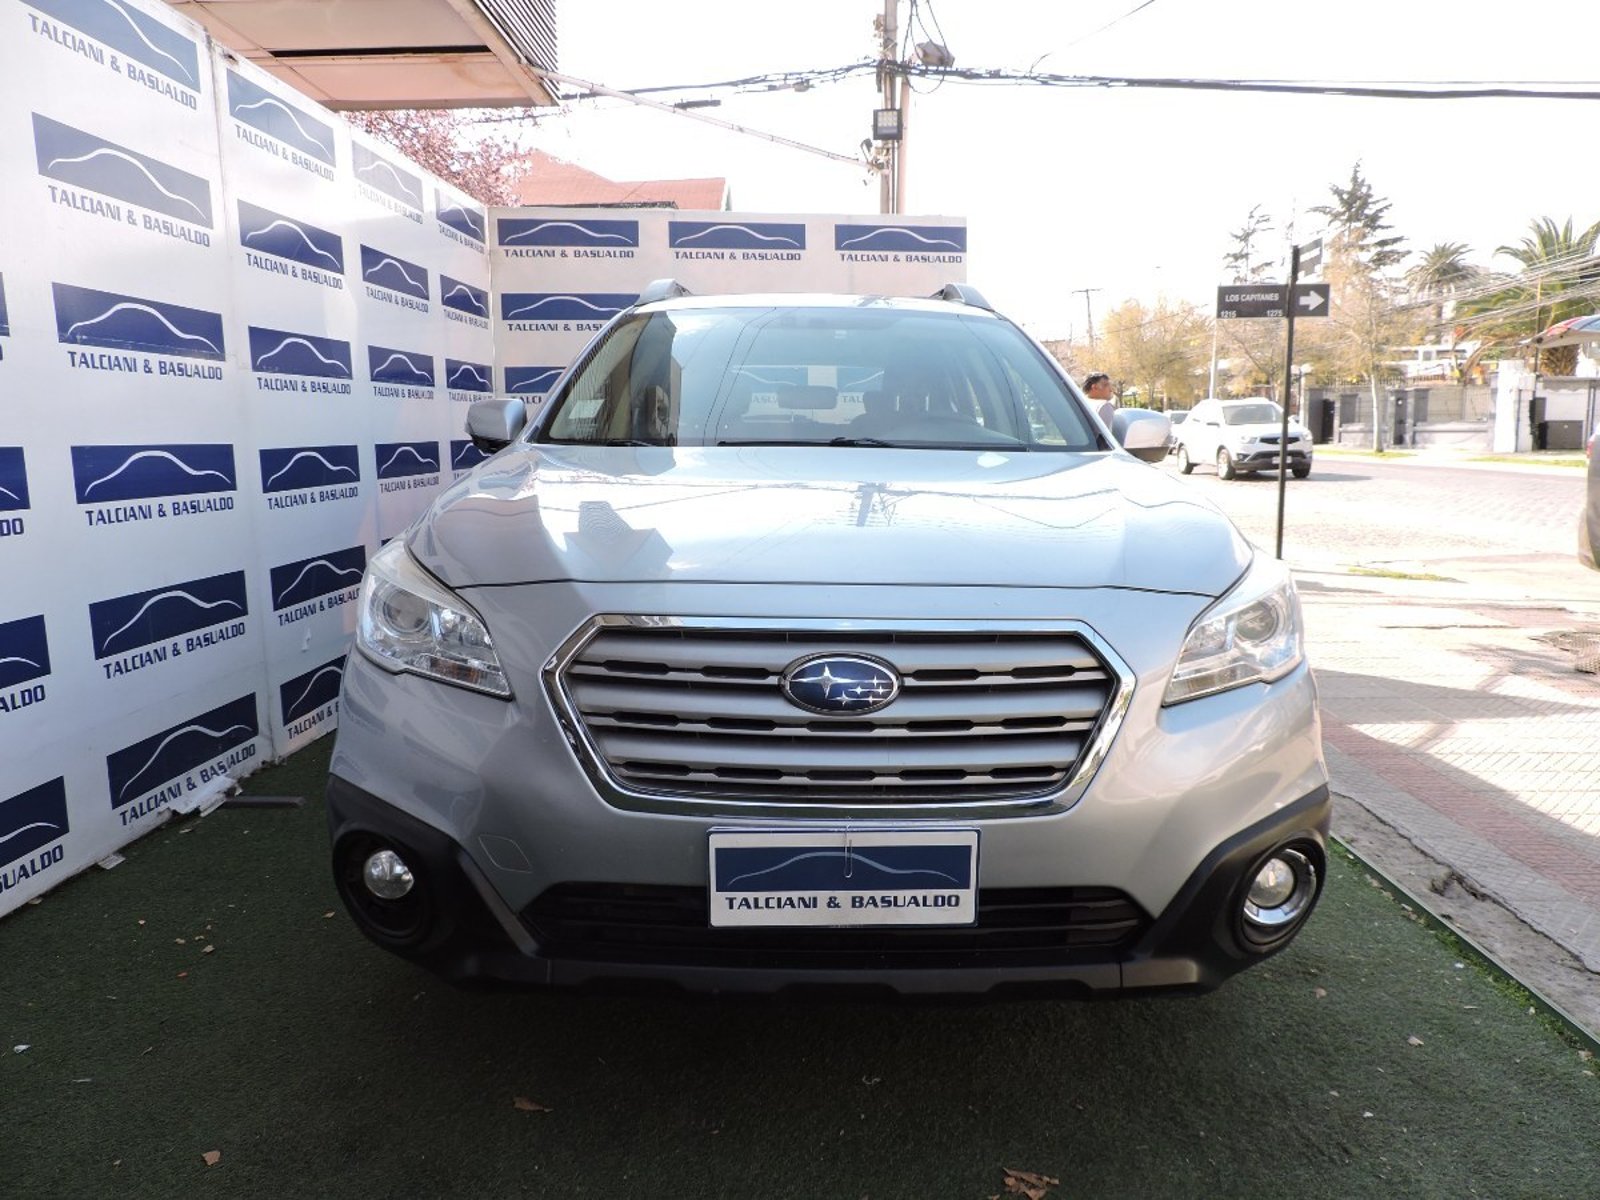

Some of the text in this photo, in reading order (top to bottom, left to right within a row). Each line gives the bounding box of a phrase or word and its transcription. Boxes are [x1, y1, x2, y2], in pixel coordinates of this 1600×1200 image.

[28, 13, 197, 110] TALCIANI & BASUALDO
[48, 184, 210, 247] TALCIANI & BASUALDO
[504, 249, 635, 259] TALCIANI & BASUALDO
[675, 251, 801, 261] TALCIANI & BASUALDO
[840, 253, 963, 264] TALCIANI & BASUALDO
[1225, 293, 1280, 302] LOS CAPITANES
[508, 323, 558, 332] TALCIANI
[563, 324, 571, 332] &
[67, 350, 223, 380] TALCIANI & BASUALDO
[85, 496, 234, 526] TALCIANI & BASUALDO
[278, 603, 317, 626] TALCIANI
[103, 622, 245, 679] TALCIANI & BASUALDO
[119, 782, 182, 826] TALCIANI
[187, 777, 197, 790] &
[0, 844, 64, 894] UALDO
[725, 894, 960, 910] TALCIANI & BASUALDO
